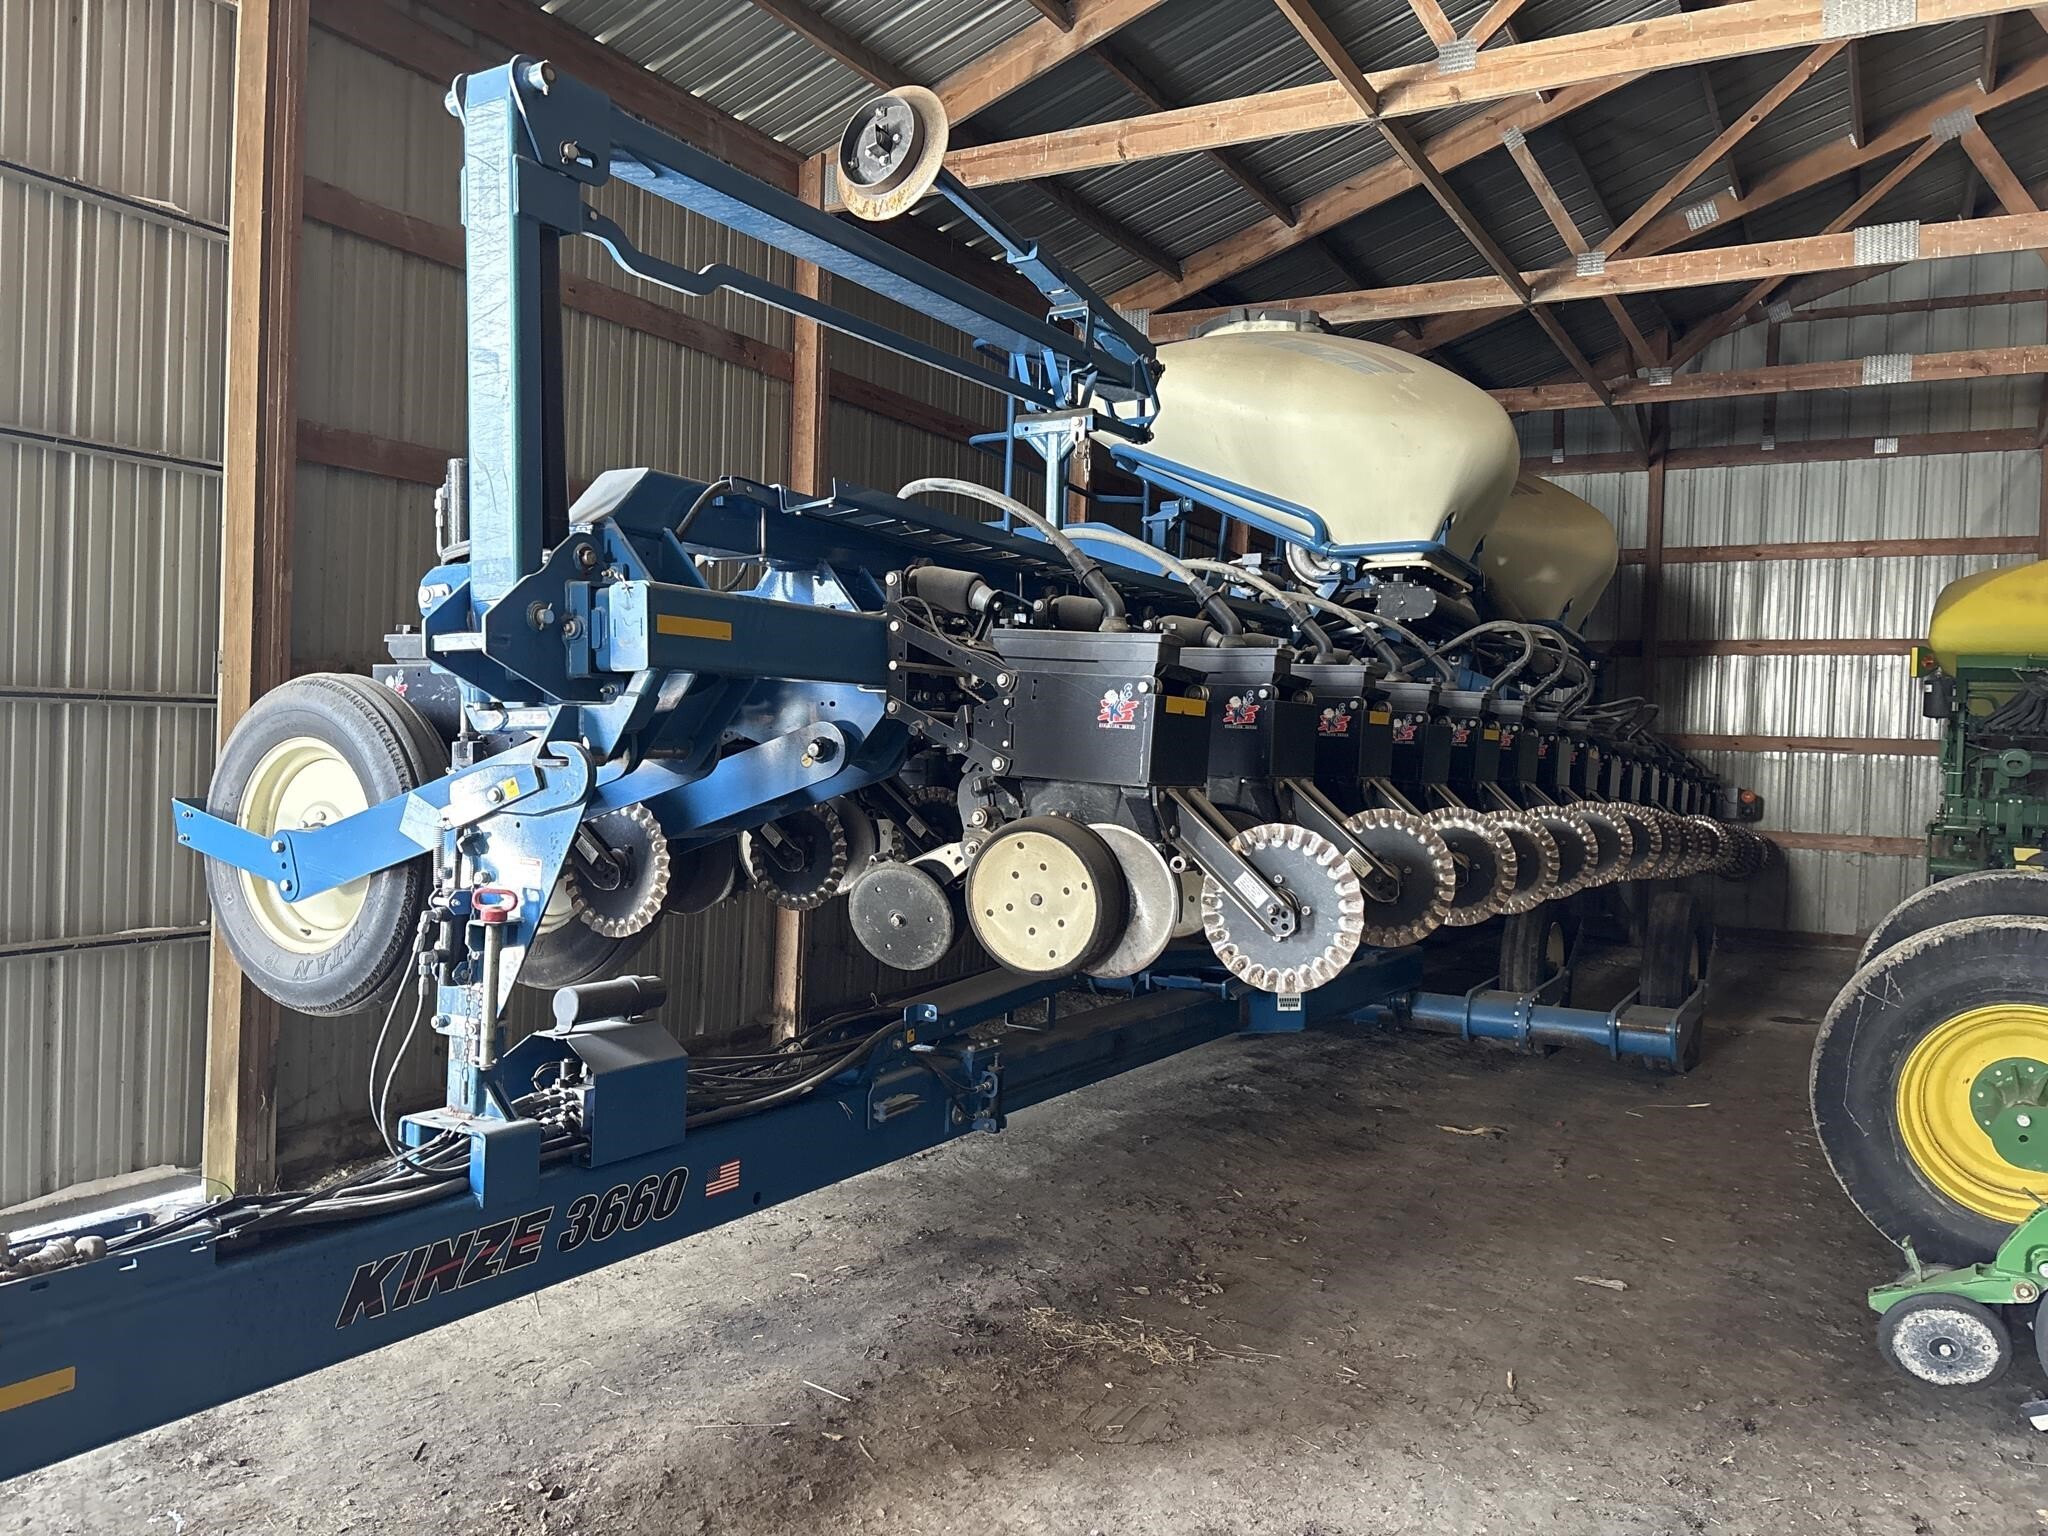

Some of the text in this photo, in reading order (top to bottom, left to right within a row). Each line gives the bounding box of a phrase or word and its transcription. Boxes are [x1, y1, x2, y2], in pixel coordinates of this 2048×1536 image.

[292, 920, 364, 981] TITAN
[335, 1166, 689, 1330] KINZE 3660
